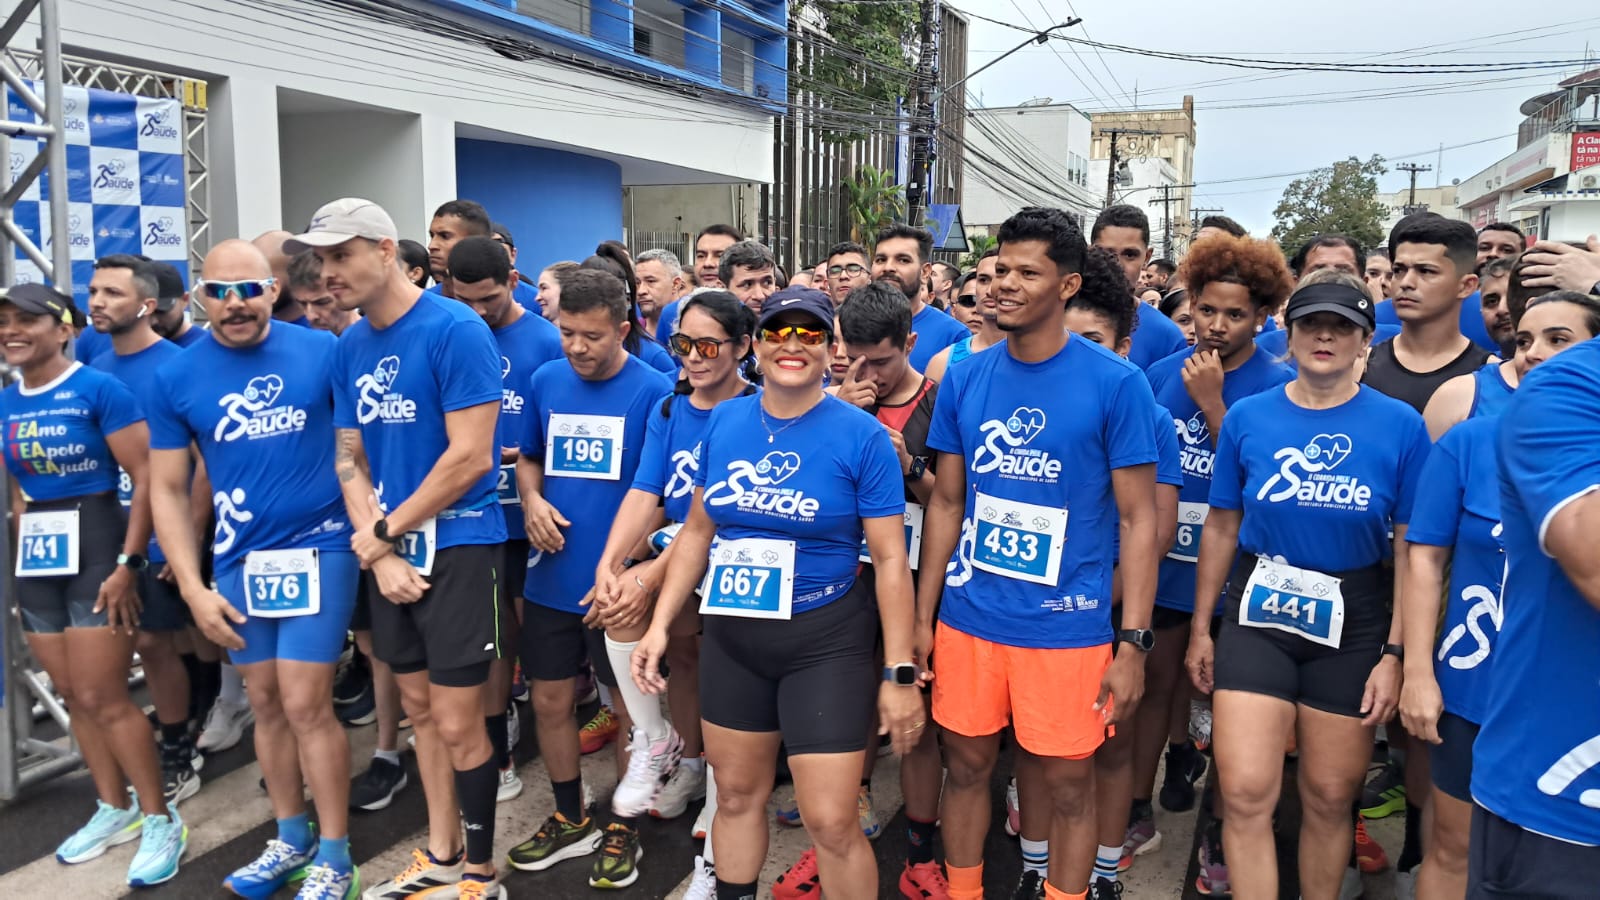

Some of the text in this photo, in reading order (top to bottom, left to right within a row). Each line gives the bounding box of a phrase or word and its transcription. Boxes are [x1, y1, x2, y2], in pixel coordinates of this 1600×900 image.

[1585, 136, 1600, 144] Cla
[562, 438, 604, 463] 196
[25, 535, 58, 560] 741
[984, 527, 1039, 562] 433
[255, 575, 300, 600] 376
[719, 567, 770, 597] 667
[1261, 592, 1317, 625] 441
